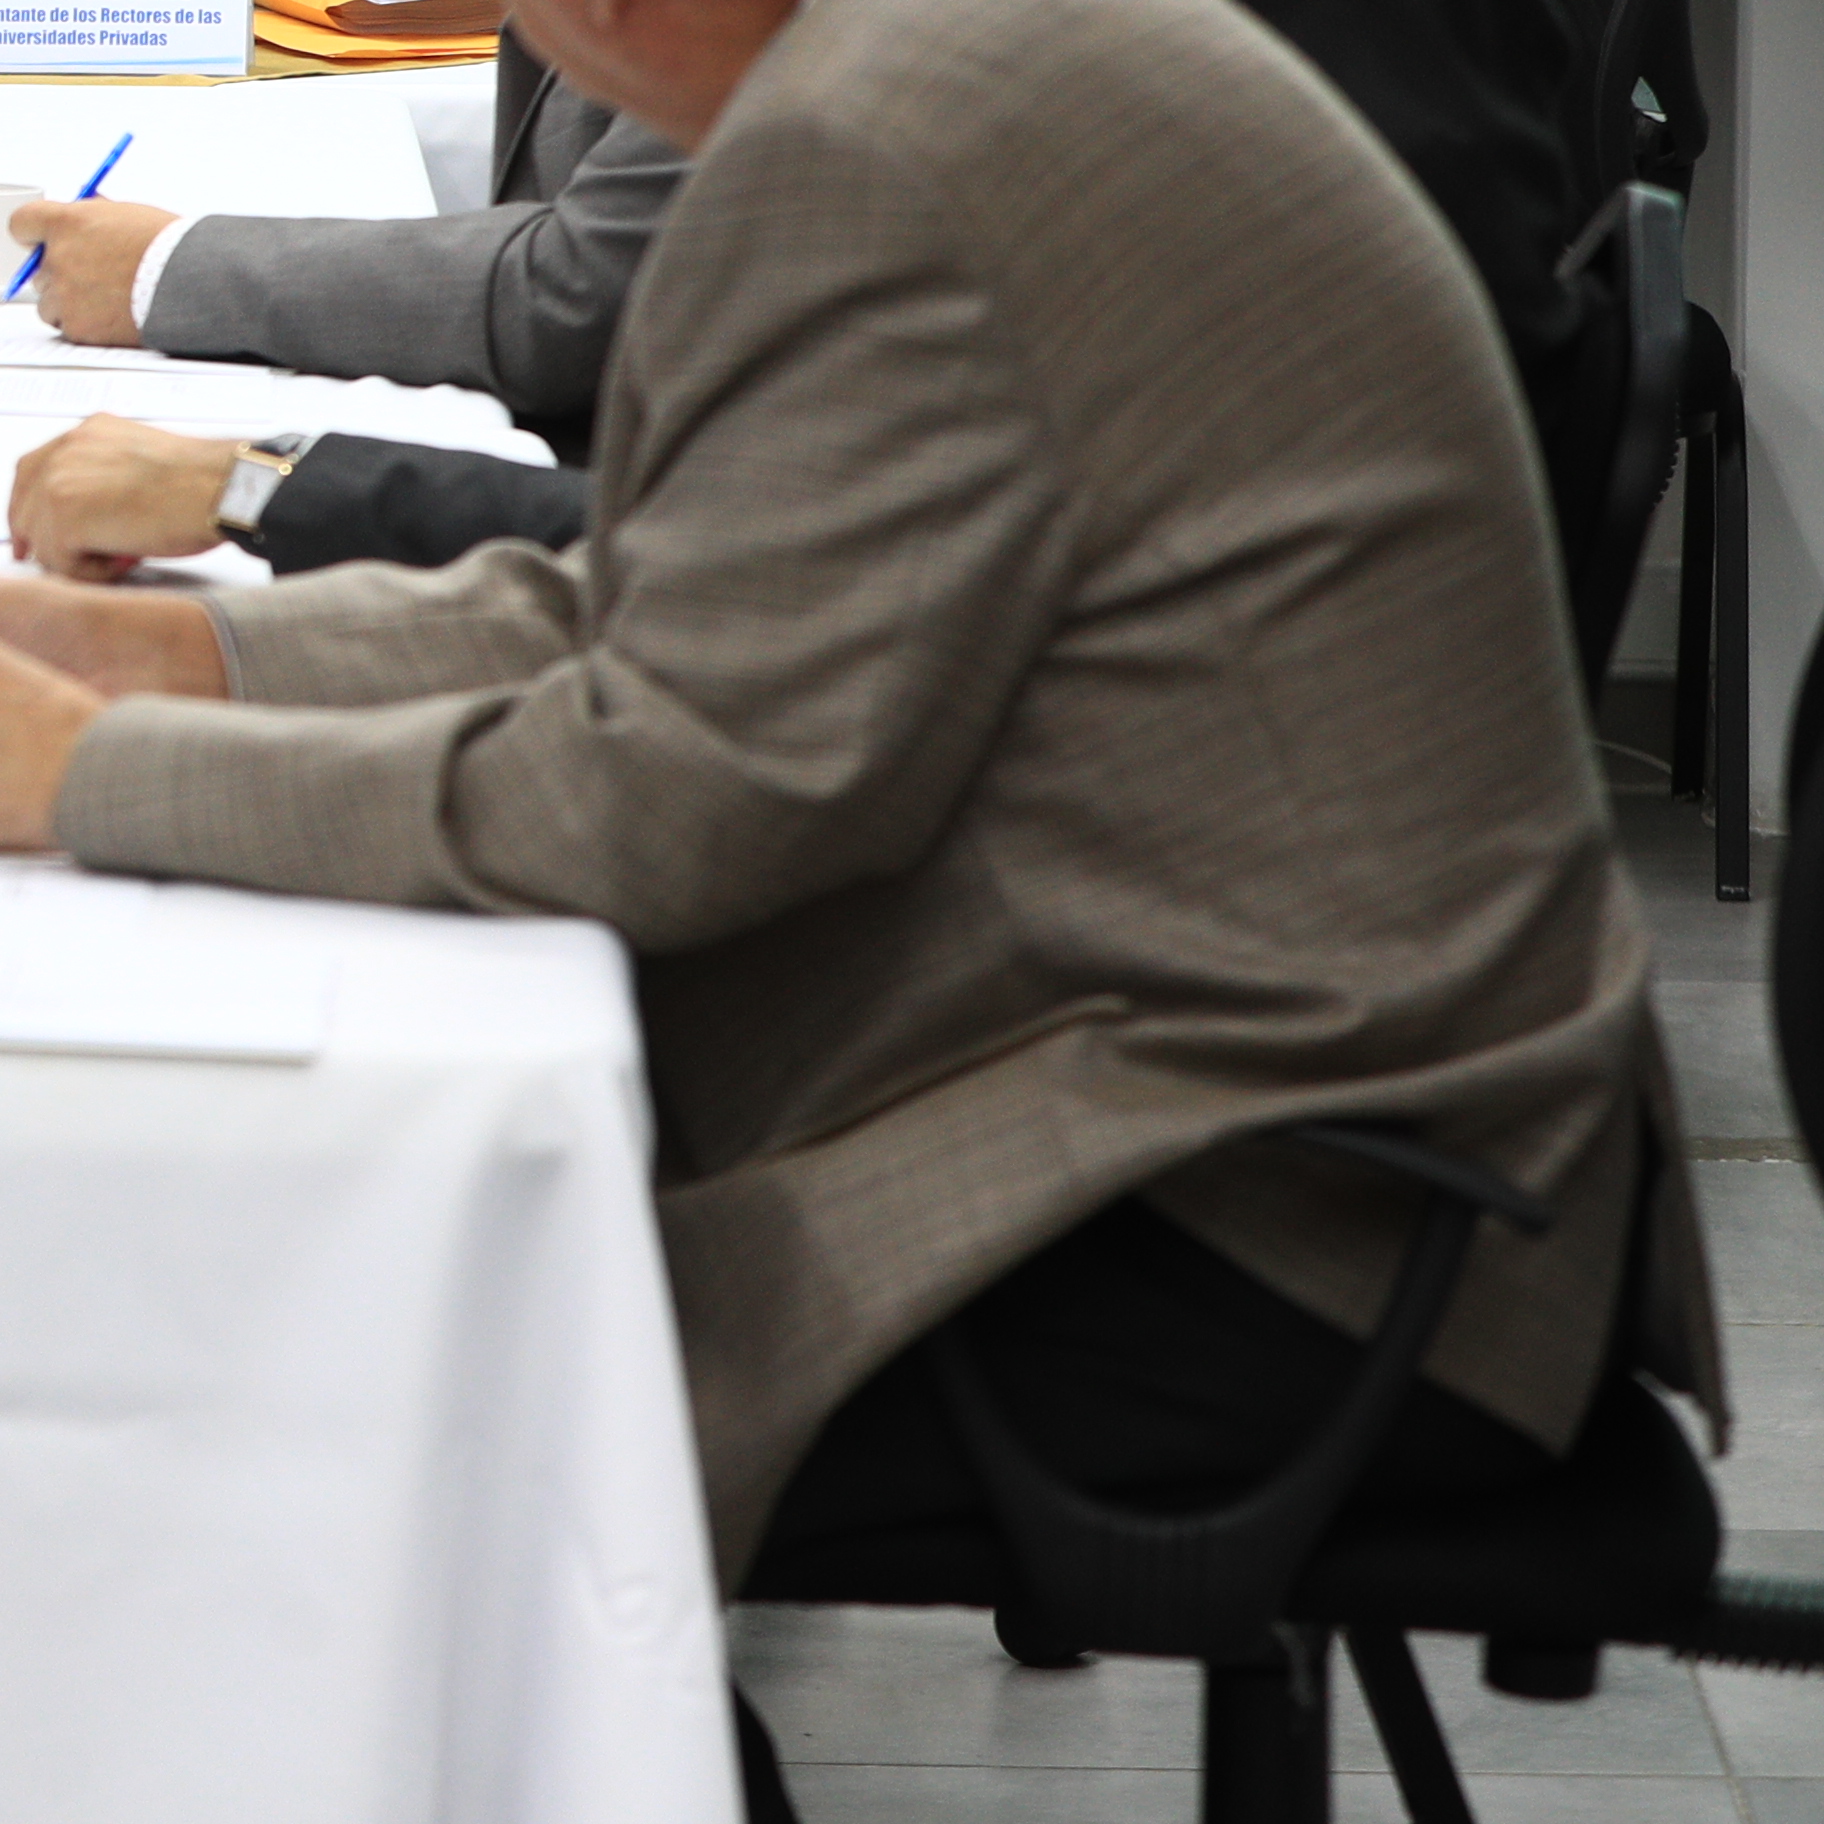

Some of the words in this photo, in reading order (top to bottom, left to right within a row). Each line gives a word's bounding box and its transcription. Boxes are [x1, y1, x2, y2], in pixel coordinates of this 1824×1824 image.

[50, 7, 69, 23] de
[73, 8, 97, 23] los
[100, 8, 172, 24] Rectores
[175, 9, 194, 24] de
[198, 9, 222, 25] las
[99, 30, 168, 46] Privadas
